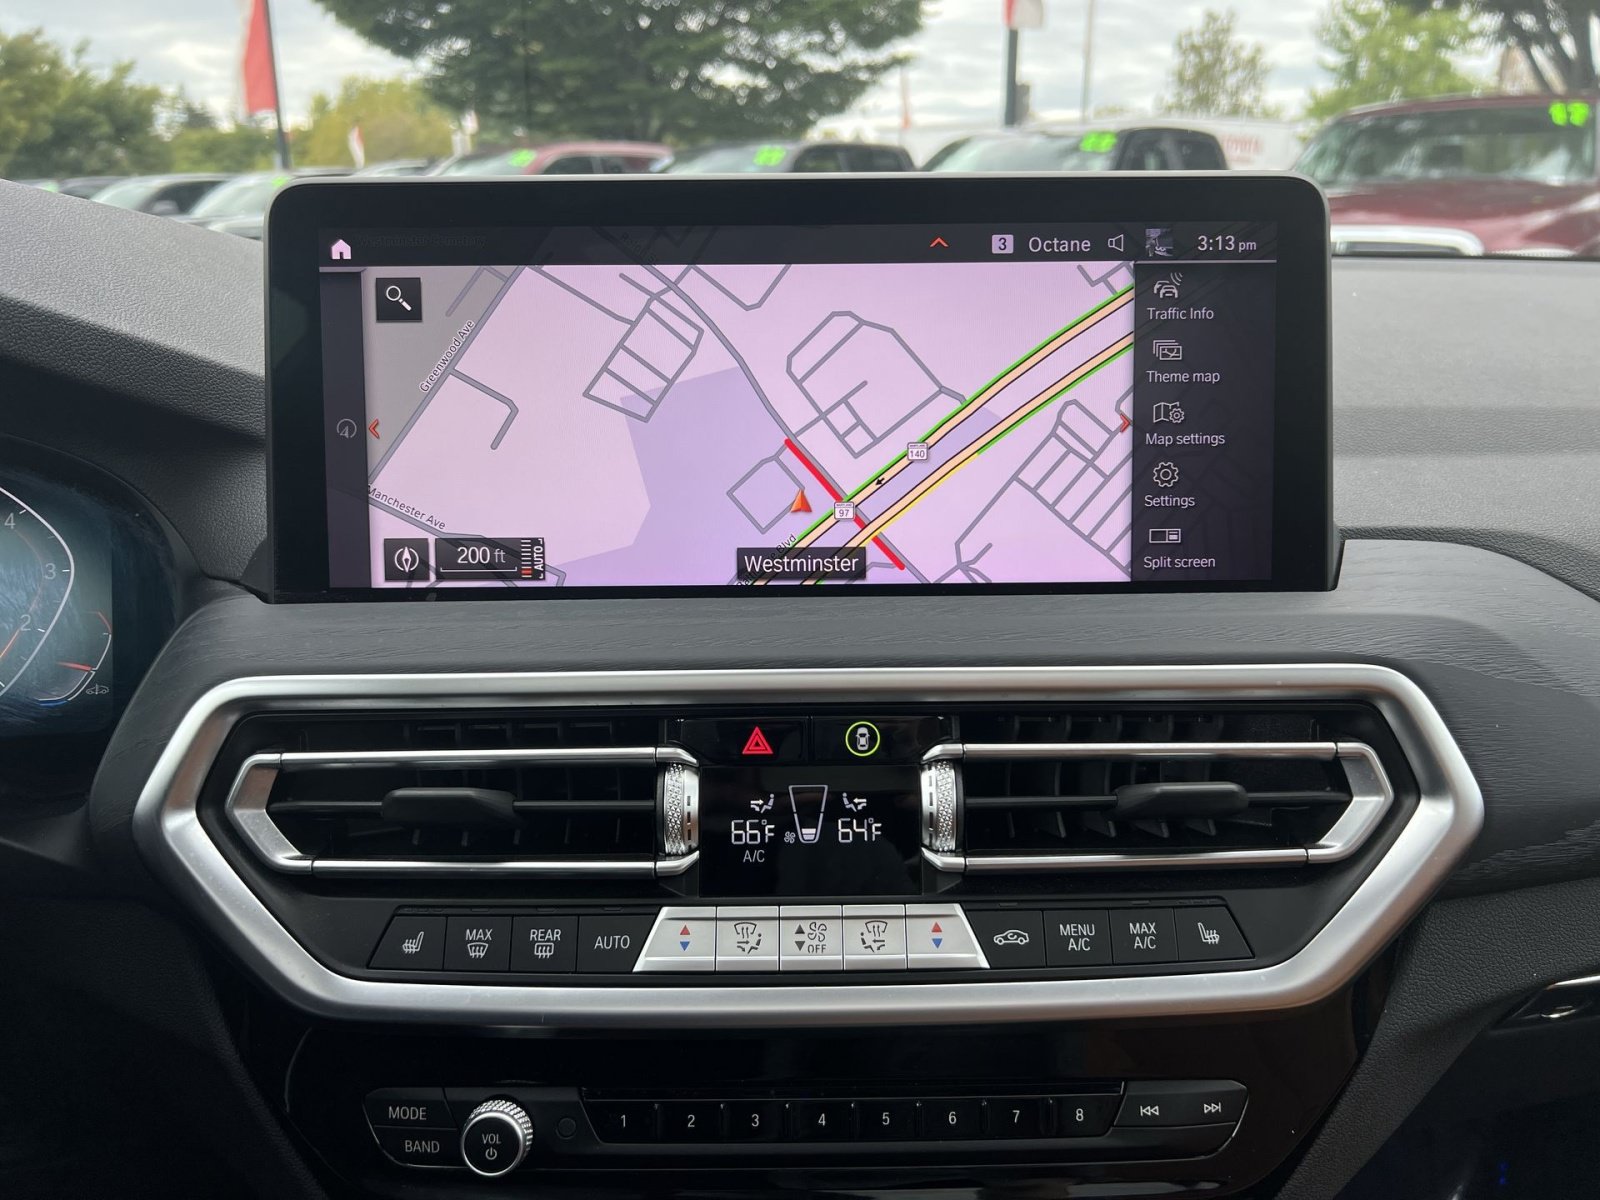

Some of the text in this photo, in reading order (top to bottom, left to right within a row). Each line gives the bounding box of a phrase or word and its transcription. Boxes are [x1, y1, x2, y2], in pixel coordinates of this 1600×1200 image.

[998, 238, 1007, 251] 3
[1028, 236, 1091, 253] Octane
[1197, 236, 1257, 254] 3:13 pm
[1147, 306, 1214, 320] Traffic Info
[420, 320, 475, 392] Greenwood Ave
[1146, 369, 1220, 384] Theme map
[1145, 432, 1225, 446] Map settings
[910, 449, 926, 458] 140
[367, 485, 446, 530] Manchester Ave
[1144, 494, 1195, 508] Settings
[838, 509, 850, 517] 97
[4, 512, 16, 530] 4
[457, 546, 506, 564] 200 ft
[533, 546, 544, 571] AUTO
[744, 554, 860, 572] Westminster
[1143, 555, 1216, 571] Split screen
[44, 563, 57, 580] 3
[20, 614, 32, 632] 2
[743, 850, 765, 863] A/C
[465, 929, 492, 941] MAX
[530, 929, 562, 942] REAR
[1059, 924, 1096, 937] MENU
[1129, 922, 1156, 935] MAX
[594, 935, 630, 949] AUTO
[807, 943, 827, 954] OFF
[1068, 938, 1091, 952] A/C
[1134, 936, 1157, 950] A/C
[388, 1106, 427, 1121] MODE
[620, 1114, 627, 1127] 1
[751, 1113, 759, 1127] 3
[818, 1113, 826, 1126] 4
[882, 1112, 890, 1125] 5
[948, 1111, 957, 1125] 6
[1012, 1110, 1020, 1123] 7
[1075, 1109, 1084, 1122] 8
[687, 1114, 695, 1128] 2
[482, 1133, 502, 1145] VOL
[404, 1140, 440, 1154] BAND
